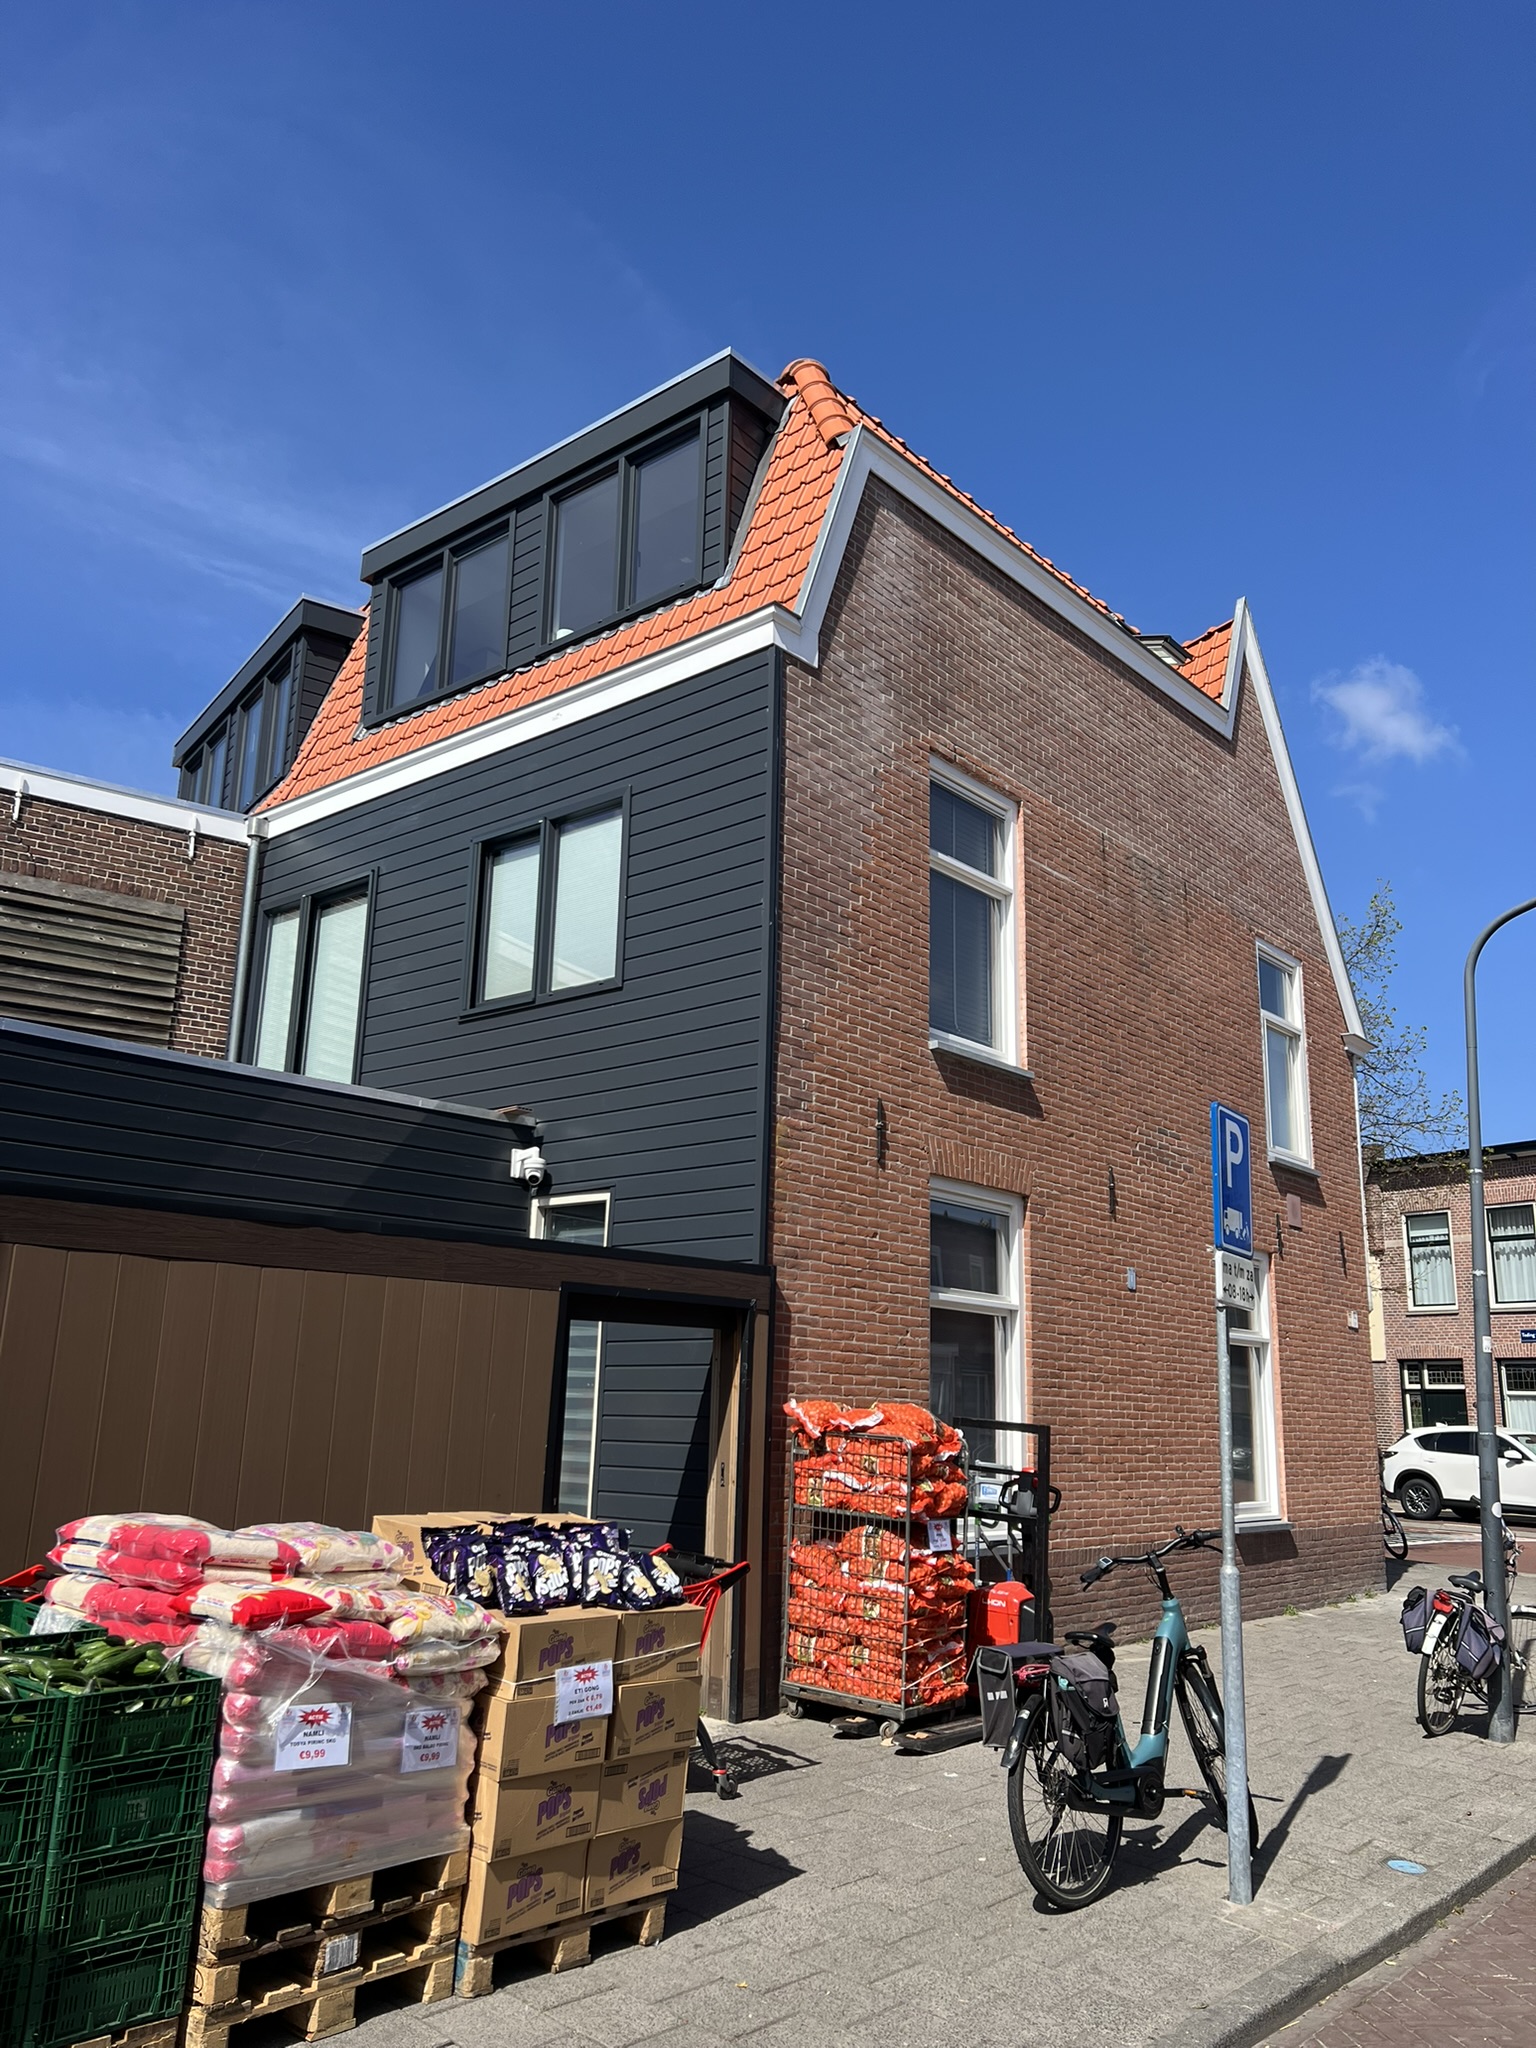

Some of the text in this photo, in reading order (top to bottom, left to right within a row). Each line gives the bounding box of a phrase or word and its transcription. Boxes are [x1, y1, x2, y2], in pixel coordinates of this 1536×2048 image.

[1225, 1118, 1243, 1188] P
[1223, 1262, 1254, 1282] ma t/m za
[1228, 1282, 1250, 1303] 08-18h
[538, 1636, 575, 1672] POPS
[635, 1626, 665, 1657] POPS
[636, 1697, 665, 1732] POPS
[303, 1730, 325, 1738] NAMLI
[299, 1748, 326, 1760] €9,99
[420, 1751, 440, 1762] €9,99
[536, 1785, 572, 1827] POPS
[638, 1773, 668, 1810] POPS
[609, 1842, 641, 1880] POPS
[507, 1867, 544, 1910] POPS
